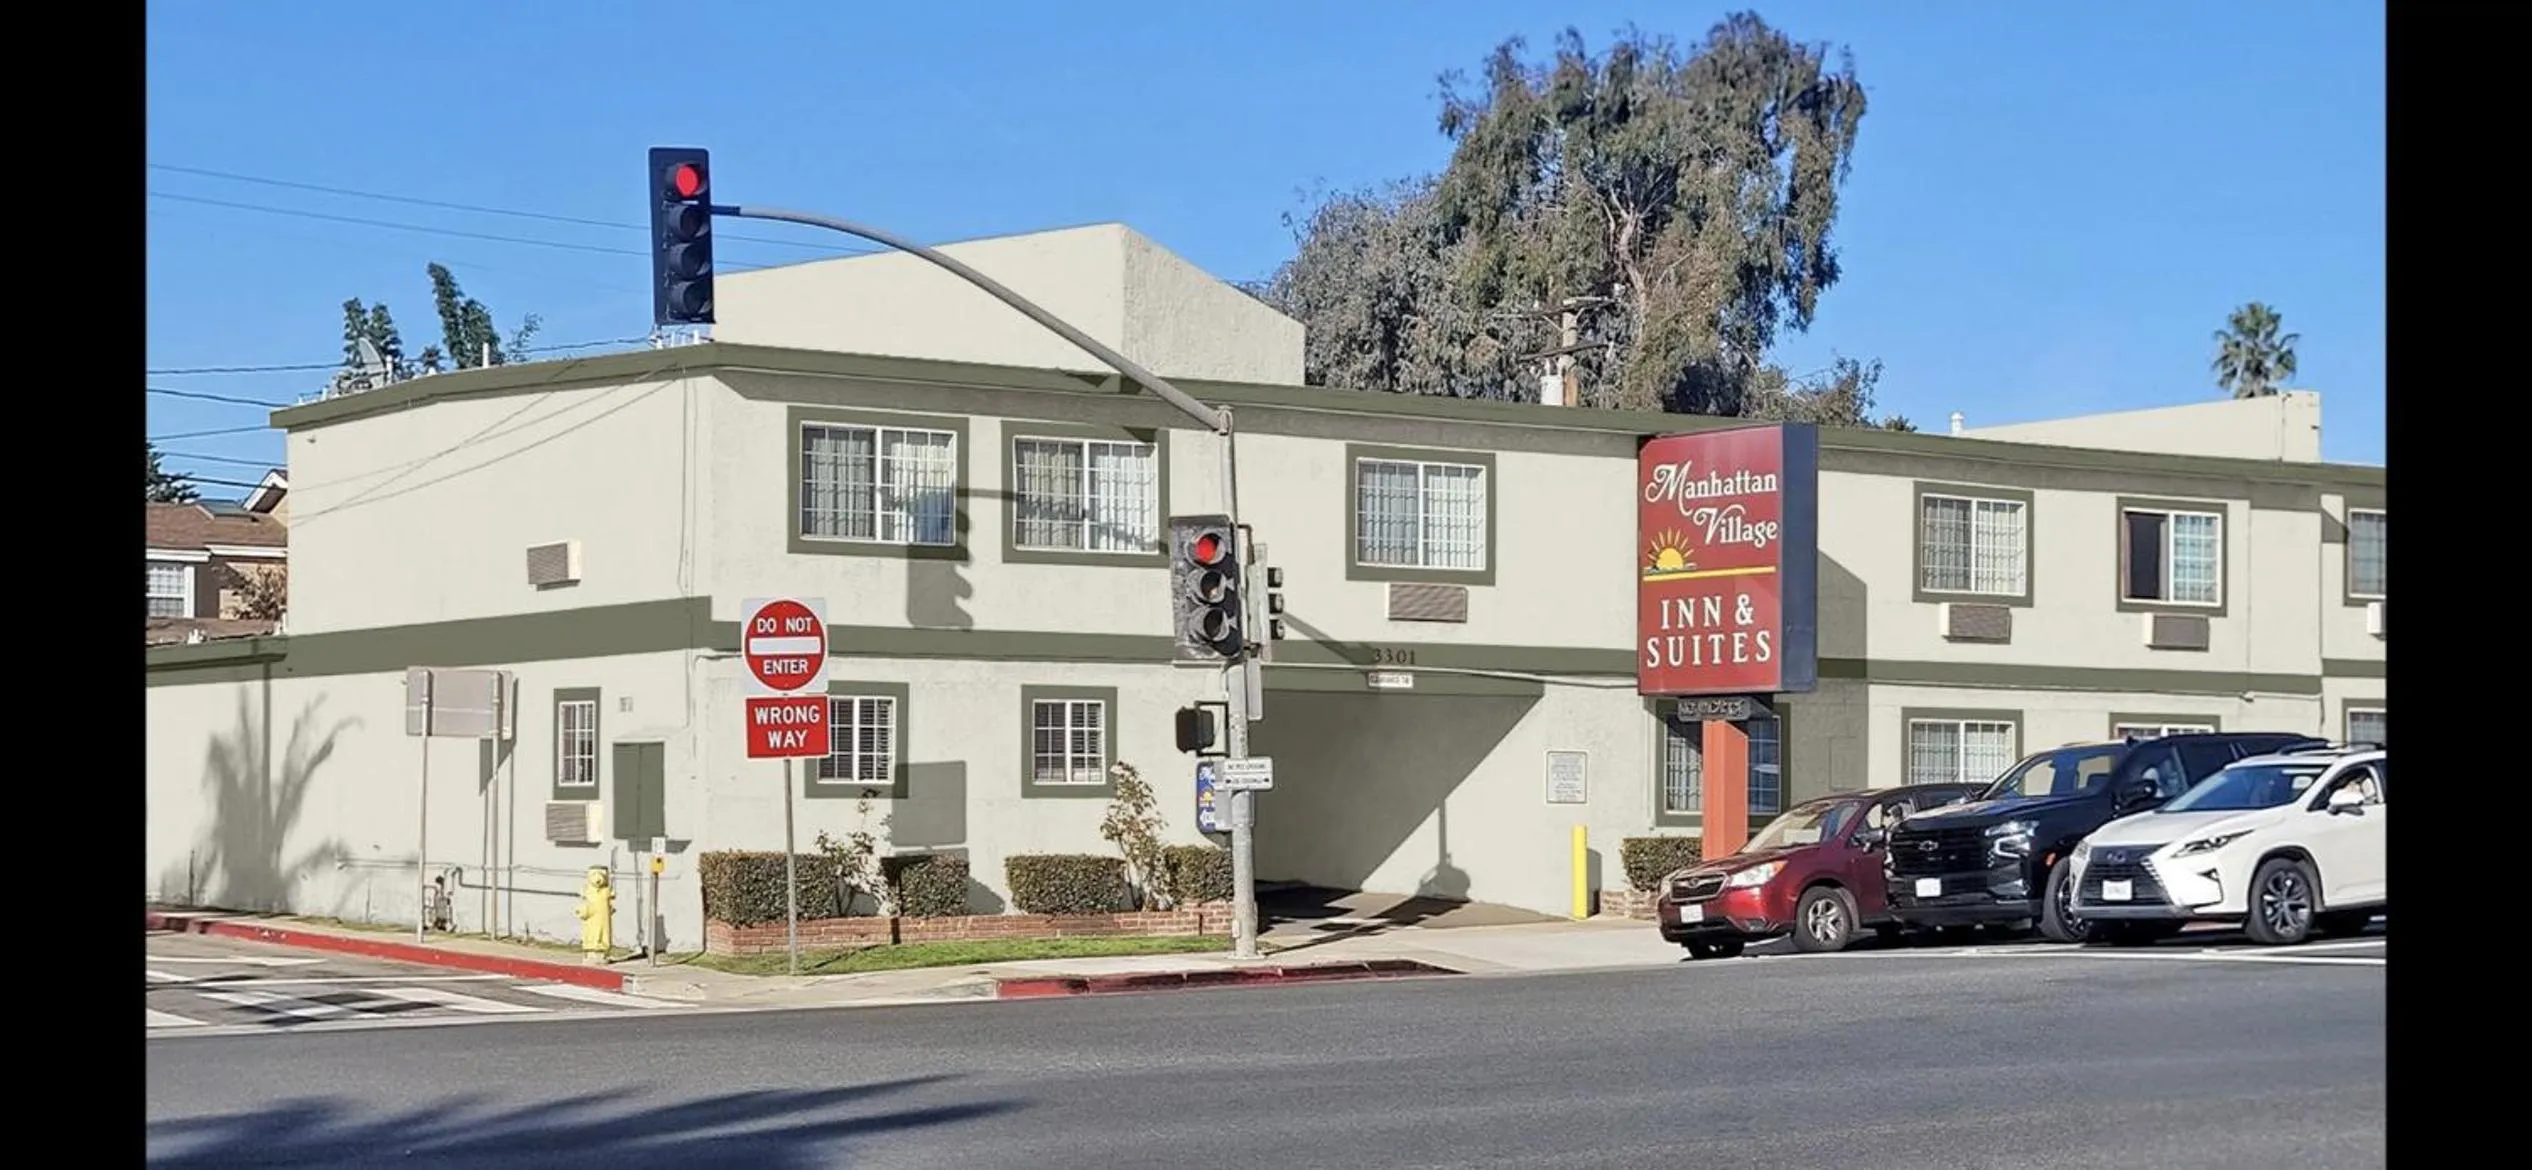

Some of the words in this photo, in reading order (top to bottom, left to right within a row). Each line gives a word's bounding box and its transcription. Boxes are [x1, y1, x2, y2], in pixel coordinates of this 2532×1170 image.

[1645, 460, 1777, 517] Manhattan
[1692, 503, 1777, 548] Village
[1660, 596, 1722, 629] INN
[1734, 593, 1754, 626] &
[756, 617, 777, 633] DO
[785, 616, 813, 633] NOT
[1372, 648, 1415, 664] 3301
[1646, 630, 1771, 668] SUITES
[762, 659, 808, 674] ENTER
[754, 705, 820, 725] WRONG
[767, 729, 808, 749] WAY
